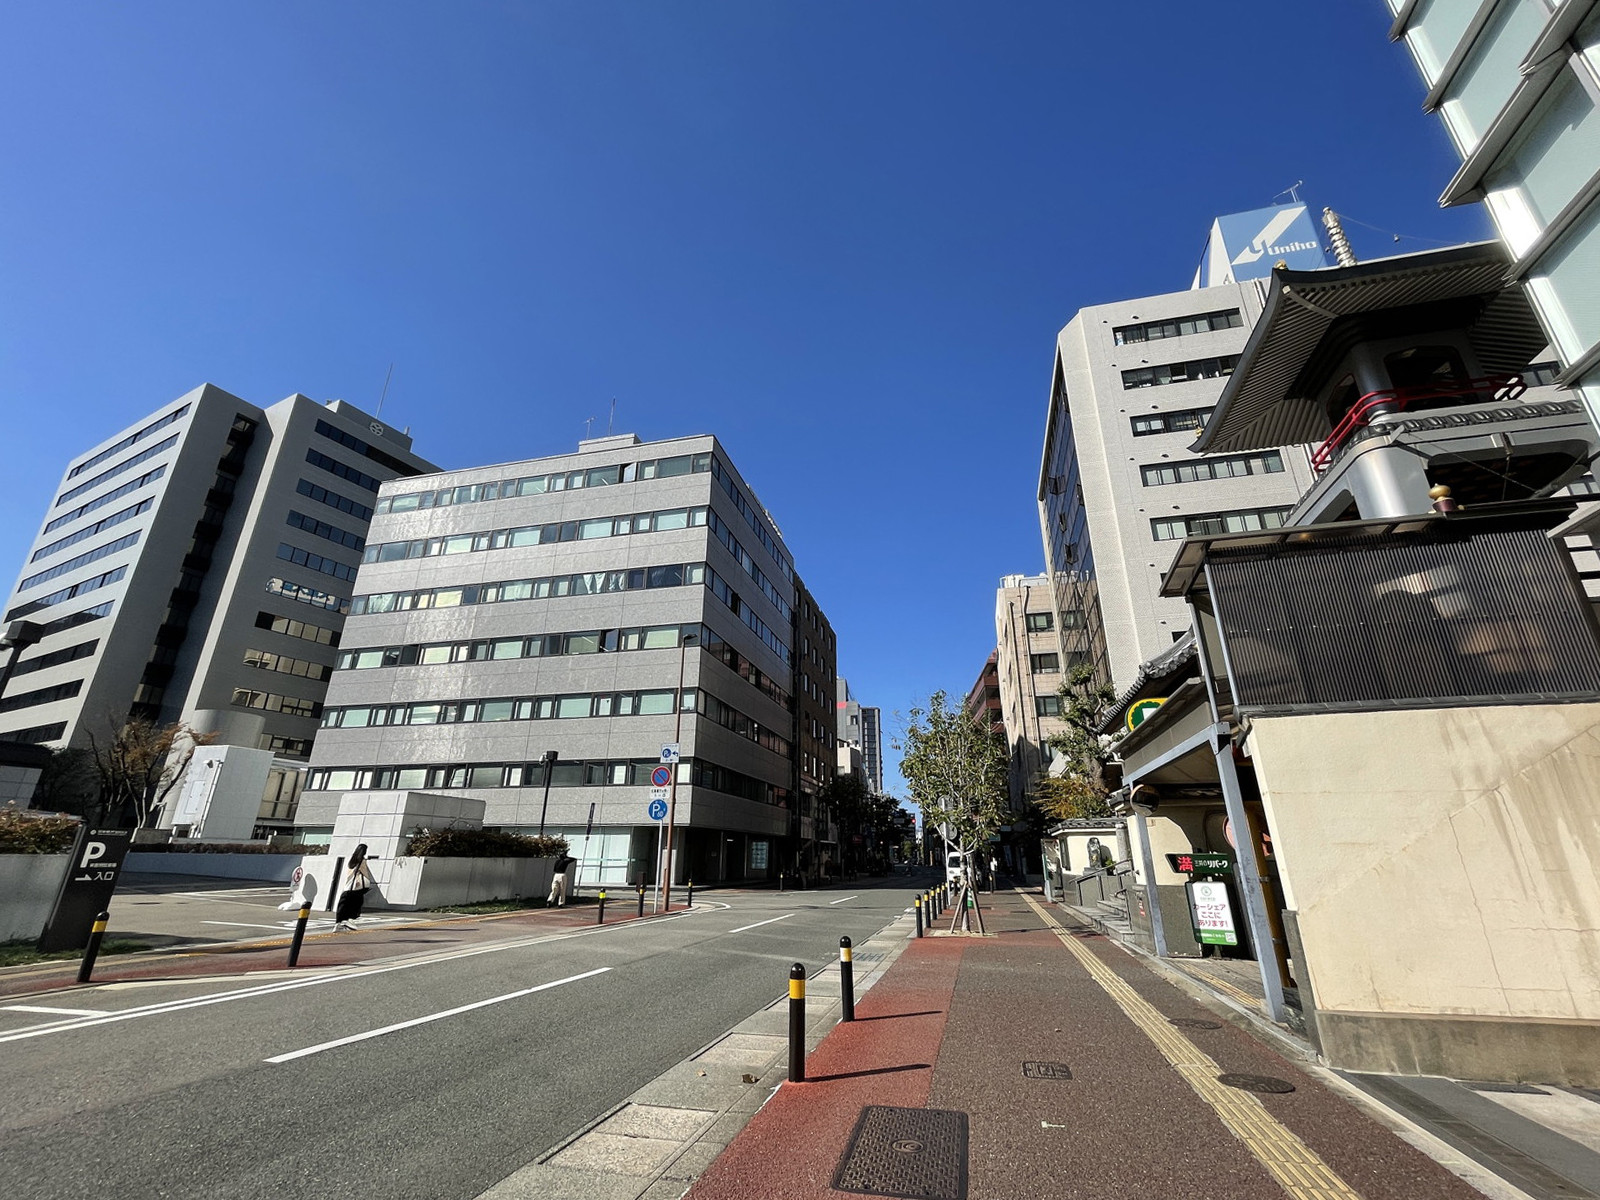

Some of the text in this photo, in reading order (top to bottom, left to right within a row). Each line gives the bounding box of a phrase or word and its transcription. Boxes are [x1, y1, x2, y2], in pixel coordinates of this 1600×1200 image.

[80, 841, 106, 868] P
[1177, 856, 1193, 871] 満
[93, 871, 114, 881] 入口
[1193, 903, 1226, 911] カーシェア
[1201, 911, 1221, 919] ここに
